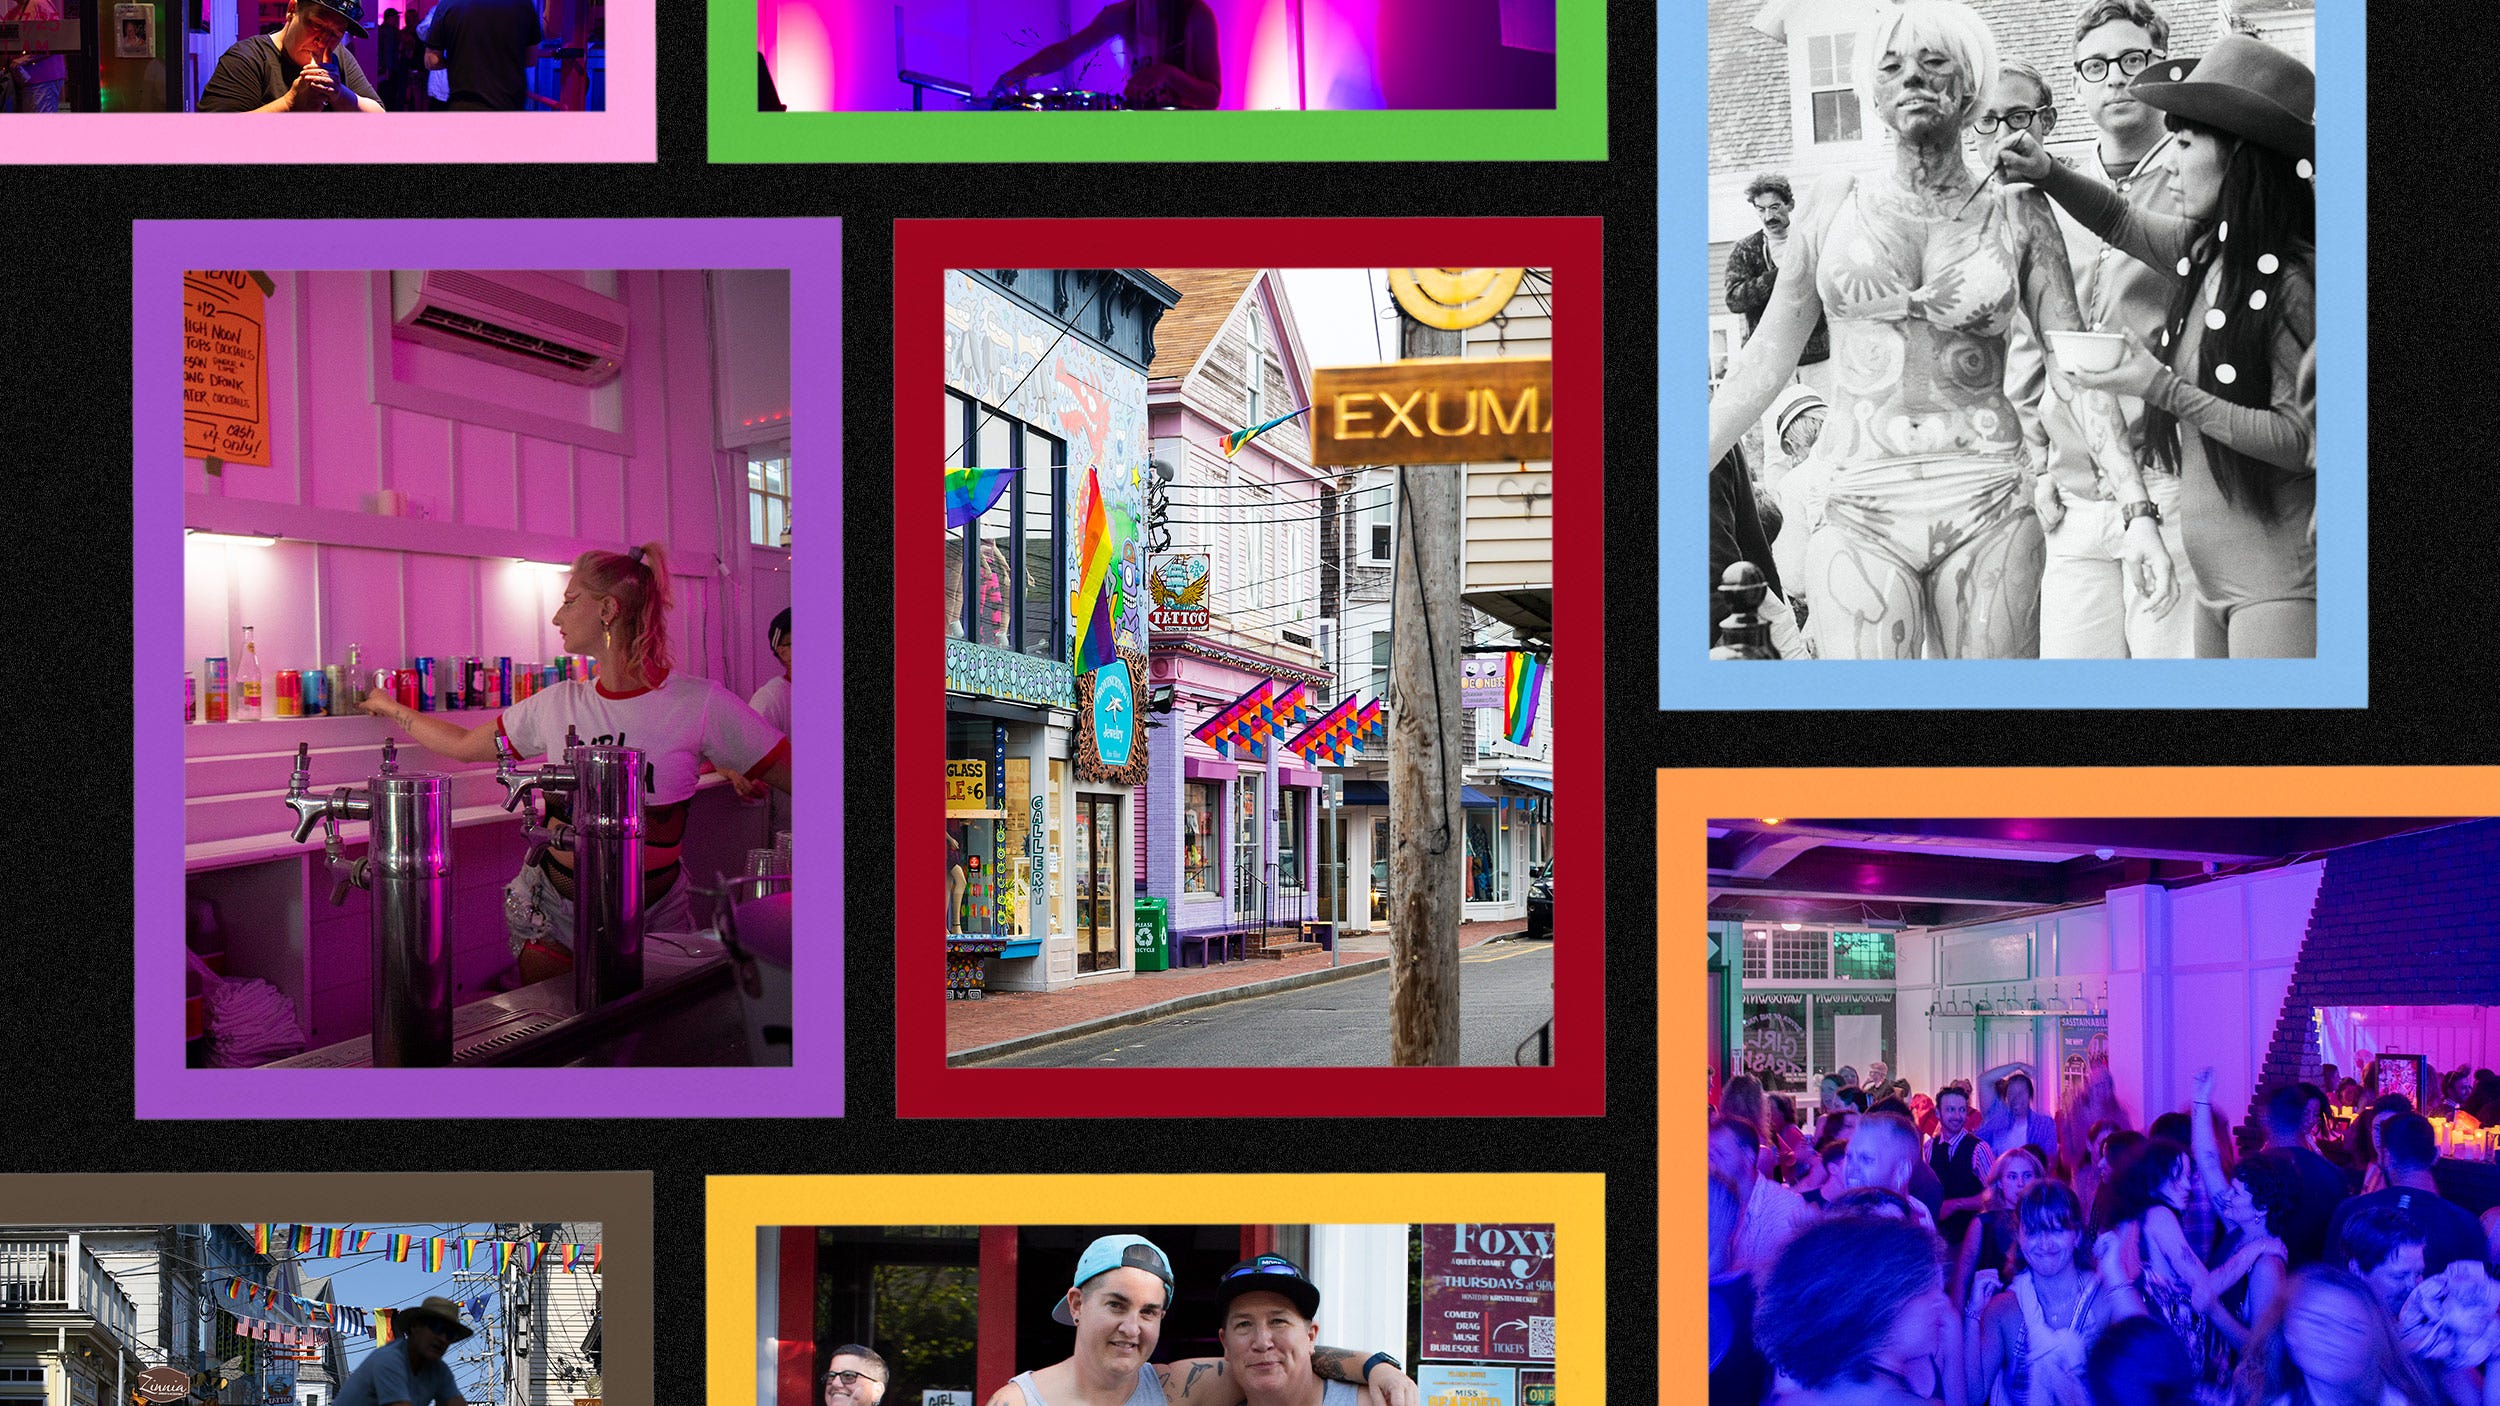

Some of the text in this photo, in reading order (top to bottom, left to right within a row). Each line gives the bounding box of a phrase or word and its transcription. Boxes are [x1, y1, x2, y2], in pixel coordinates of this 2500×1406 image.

[211, 324, 242, 345] NOON
[210, 373, 246, 394] DRINK
[227, 424, 255, 440] cash
[222, 440, 262, 458] only!
[1153, 611, 1208, 625] TATTOO
[1103, 723, 1124, 743] Jewelry
[946, 763, 983, 777] GLASS
[967, 782, 984, 800] $6
[1031, 795, 1045, 906] GALLERY
[1444, 1276, 1525, 1290] THURSDAYS
[1525, 1281, 1534, 1291] at
[1444, 1310, 1480, 1319] COMEDY
[1455, 1322, 1480, 1331] DRAG
[1453, 1333, 1480, 1342] MUSIC
[1430, 1343, 1480, 1354] BURLESQUE
[1493, 1343, 1525, 1354] TICKETS
[140, 1374, 187, 1394] Zinnia
[1455, 1390, 1478, 1398] MISS
[1529, 1390, 1546, 1401] ON
